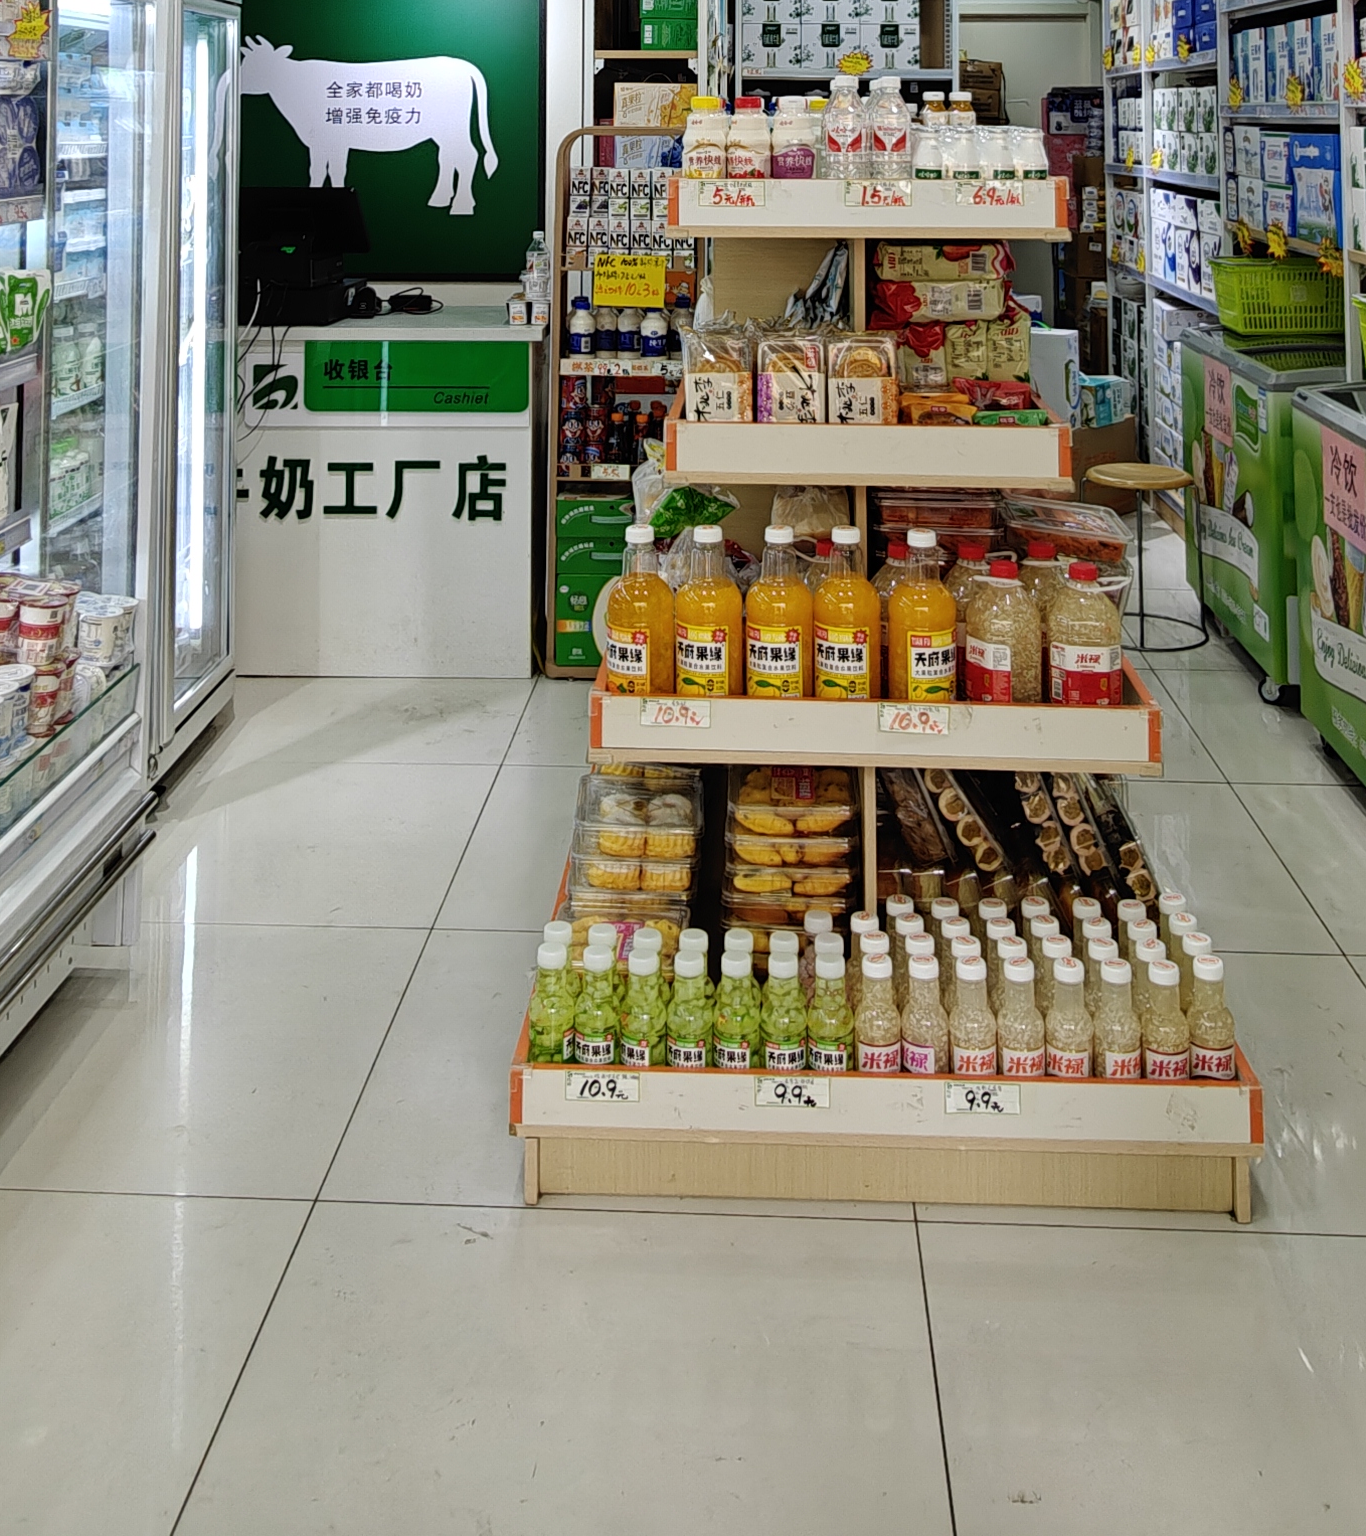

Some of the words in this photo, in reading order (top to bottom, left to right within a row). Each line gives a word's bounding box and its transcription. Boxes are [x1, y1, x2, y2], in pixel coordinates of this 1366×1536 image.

[326, 81, 423, 100] 全家都喝奶
[325, 107, 422, 125] 增强免疫力
[572, 181, 589, 195] NFC
[592, 181, 608, 194] NFC
[610, 183, 628, 196] NFC
[632, 183, 649, 196] NFC
[568, 231, 585, 245] NFC
[323, 359, 394, 382] 收银台
[1329, 445, 1359, 499] 冷饮
[677, 641, 723, 663] 天府果缘
[749, 643, 797, 662] 天府果缘
[816, 643, 864, 663] 天府果缘
[1316, 625, 1337, 670] Enjoy
[579, 1078, 629, 1100] 10.9元
[774, 1083, 816, 1108] 9.9元
[965, 1089, 1005, 1113] 9.9元
